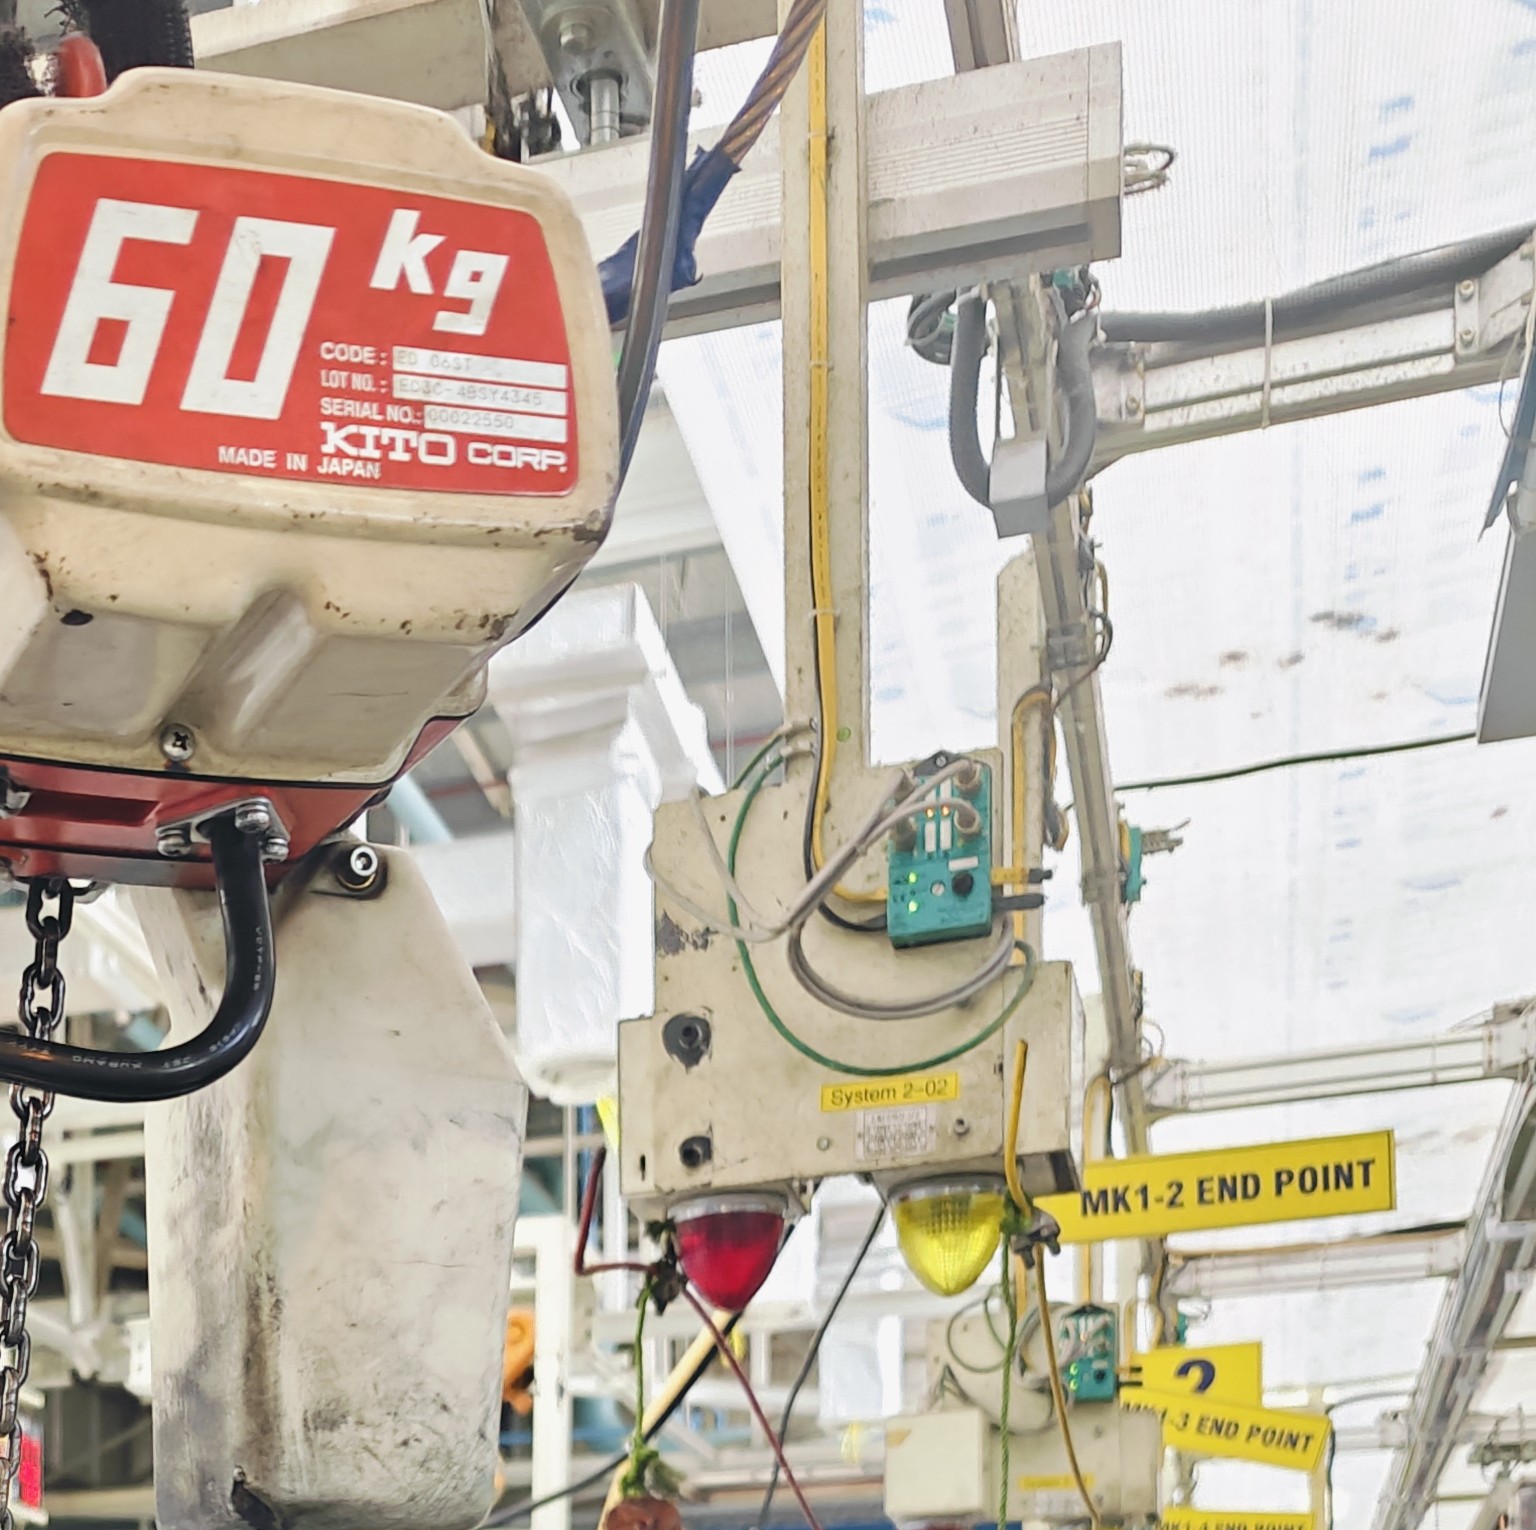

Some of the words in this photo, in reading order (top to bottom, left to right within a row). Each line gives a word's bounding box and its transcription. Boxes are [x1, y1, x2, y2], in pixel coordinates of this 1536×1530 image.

[40, 197, 336, 420] 60
[369, 208, 510, 336] kg
[320, 369, 351, 389] LOT
[320, 397, 384, 420] SERIAL
[218, 445, 276, 469] MADE
[286, 452, 309, 472] IN
[316, 456, 382, 480] JAPAN
[320, 421, 457, 466] KITO
[467, 442, 568, 473] CORP.
[831, 1086, 897, 1108] System
[903, 1079, 948, 1099] 2-02
[1080, 1181, 1184, 1218] MK1-2
[1197, 1172, 1261, 1206] END
[1274, 1158, 1377, 1197] POINT
[1195, 1413, 1240, 1440] END
[1245, 1424, 1315, 1454] POINT
